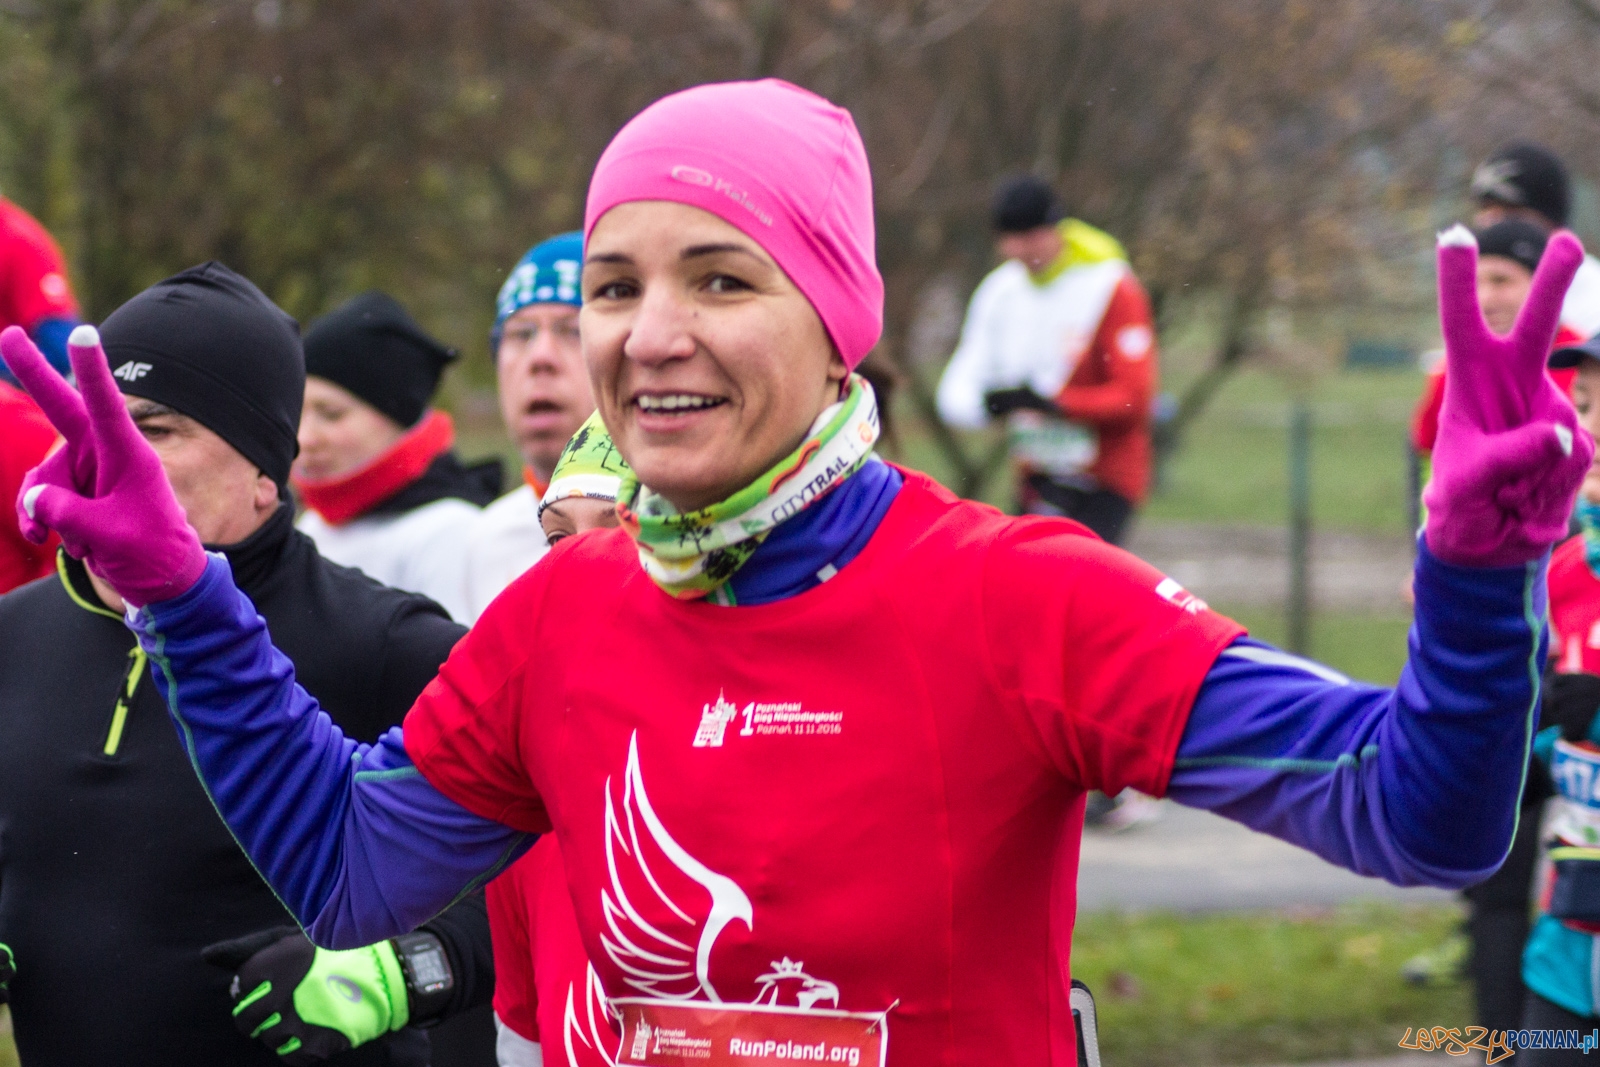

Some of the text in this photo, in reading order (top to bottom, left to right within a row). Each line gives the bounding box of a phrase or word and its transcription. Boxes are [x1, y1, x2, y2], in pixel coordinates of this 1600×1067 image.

[113, 361, 153, 381] 4F
[740, 701, 755, 736] 1
[729, 1037, 860, 1067] RunPoland.org
